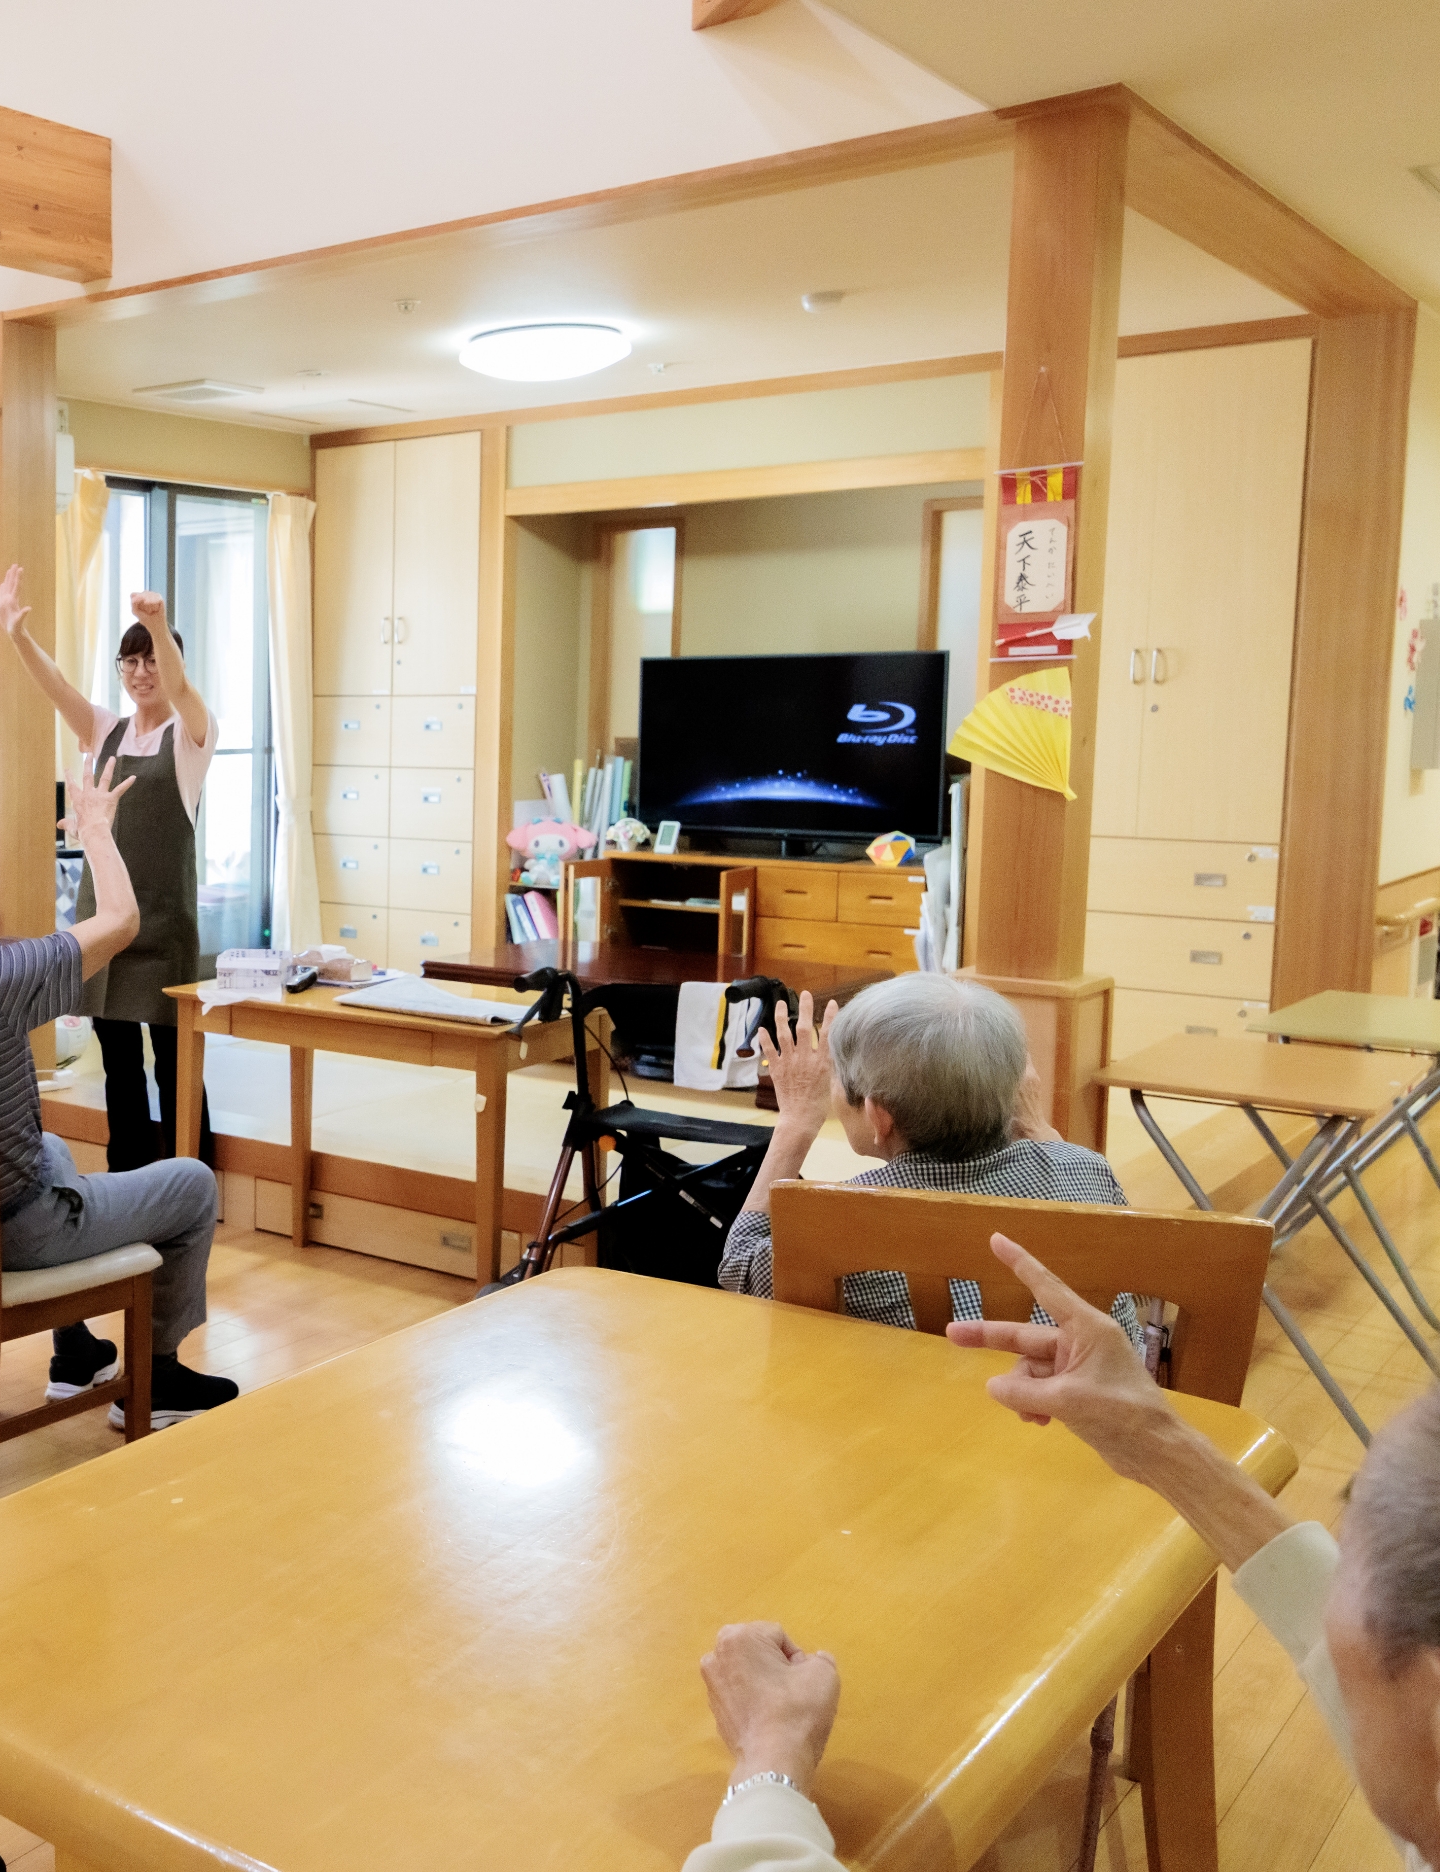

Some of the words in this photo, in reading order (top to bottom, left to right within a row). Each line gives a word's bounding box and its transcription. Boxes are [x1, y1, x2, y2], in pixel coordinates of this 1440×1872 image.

[1013, 530, 1038, 612] 天下泰平
[836, 733, 887, 746] Blu-ray
[886, 733, 918, 744] Disc
